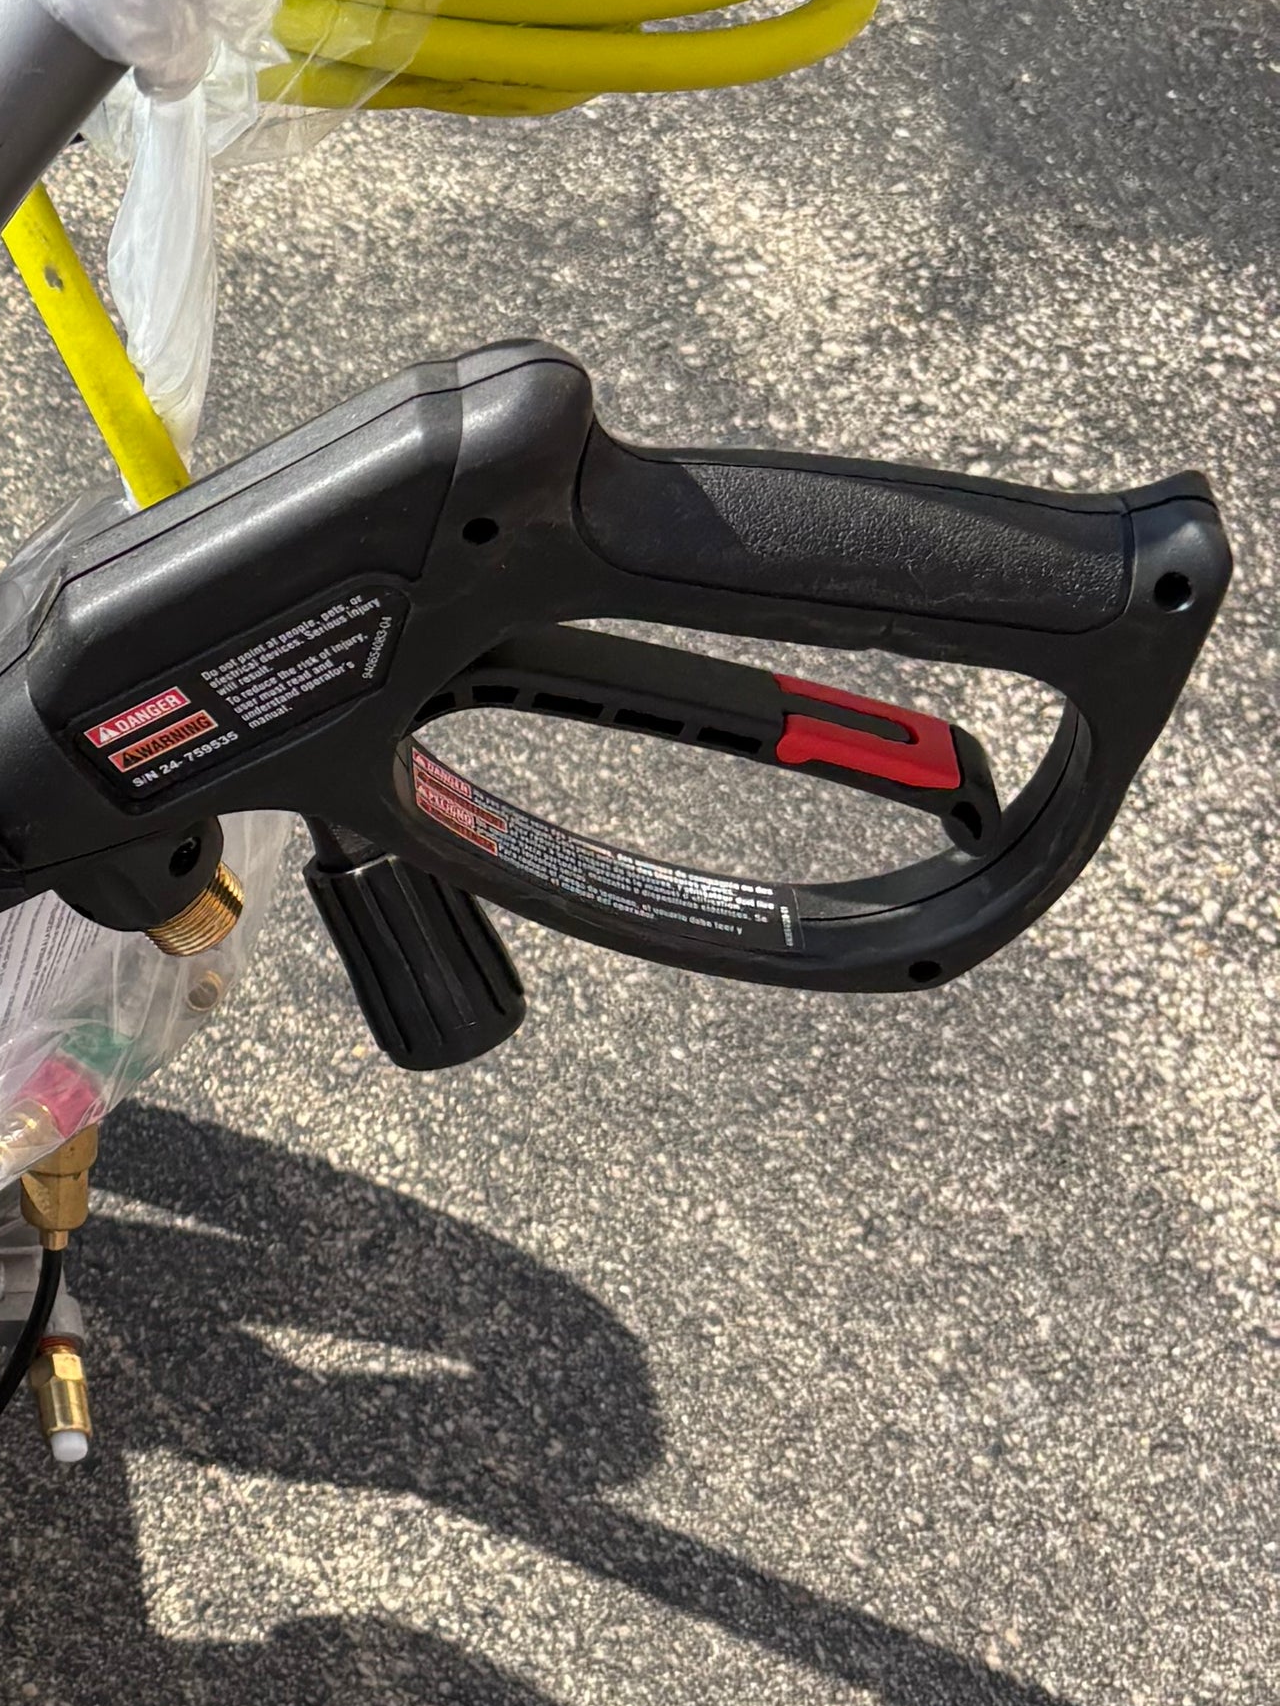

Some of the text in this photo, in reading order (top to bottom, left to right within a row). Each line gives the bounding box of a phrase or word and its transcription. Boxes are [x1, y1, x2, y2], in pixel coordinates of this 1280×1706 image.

[201, 669, 218, 680] Do
[115, 694, 182, 732] DANGER
[135, 716, 210, 760] WARNING
[132, 770, 159, 787] S/N
